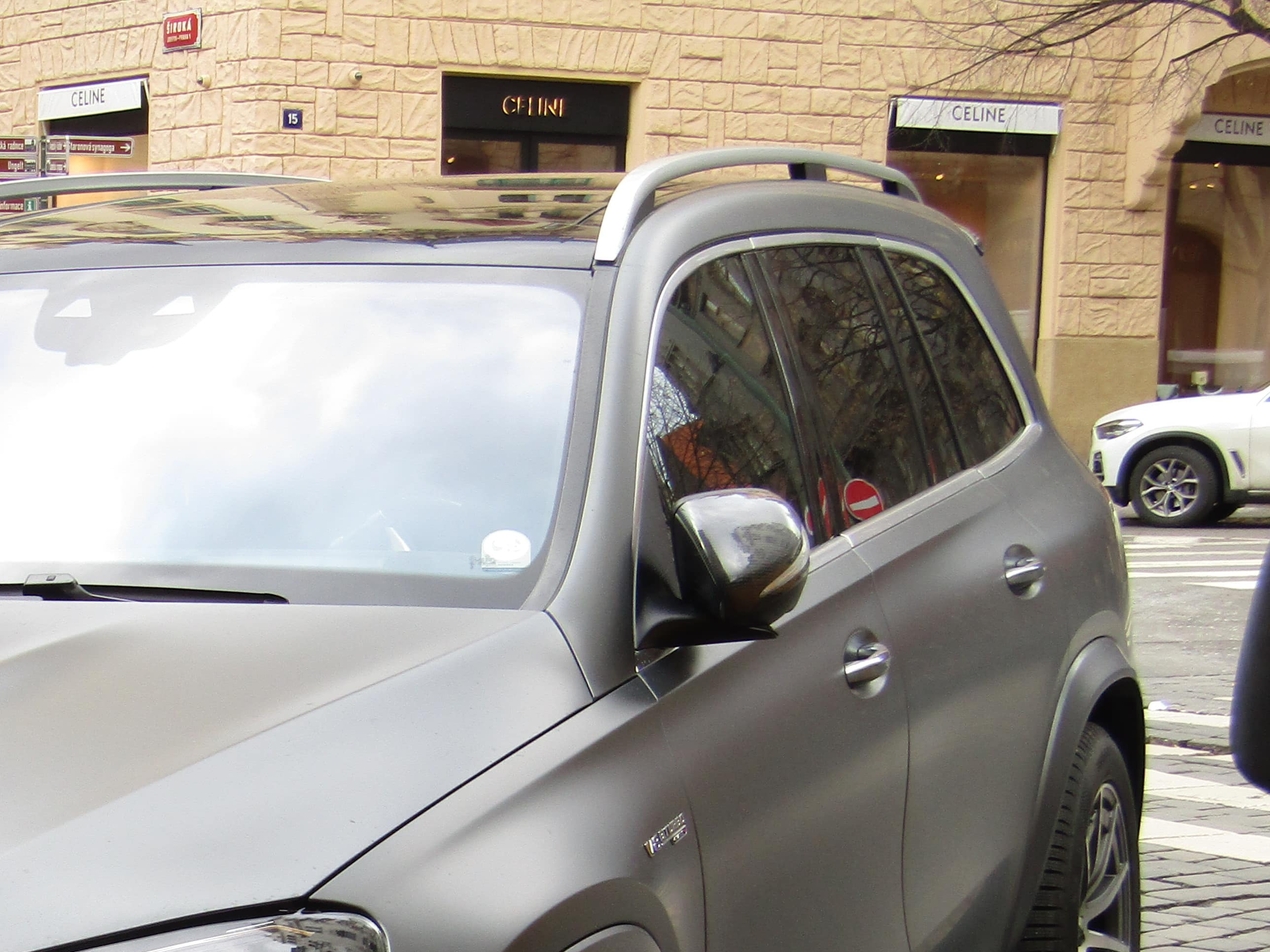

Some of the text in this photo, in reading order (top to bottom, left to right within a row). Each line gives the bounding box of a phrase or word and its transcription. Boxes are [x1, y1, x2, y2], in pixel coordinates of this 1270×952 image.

[71, 88, 106, 108] CELINE
[287, 113, 299, 125] 15
[951, 105, 1006, 123] CELINE
[1214, 118, 1264, 136] CELINE
